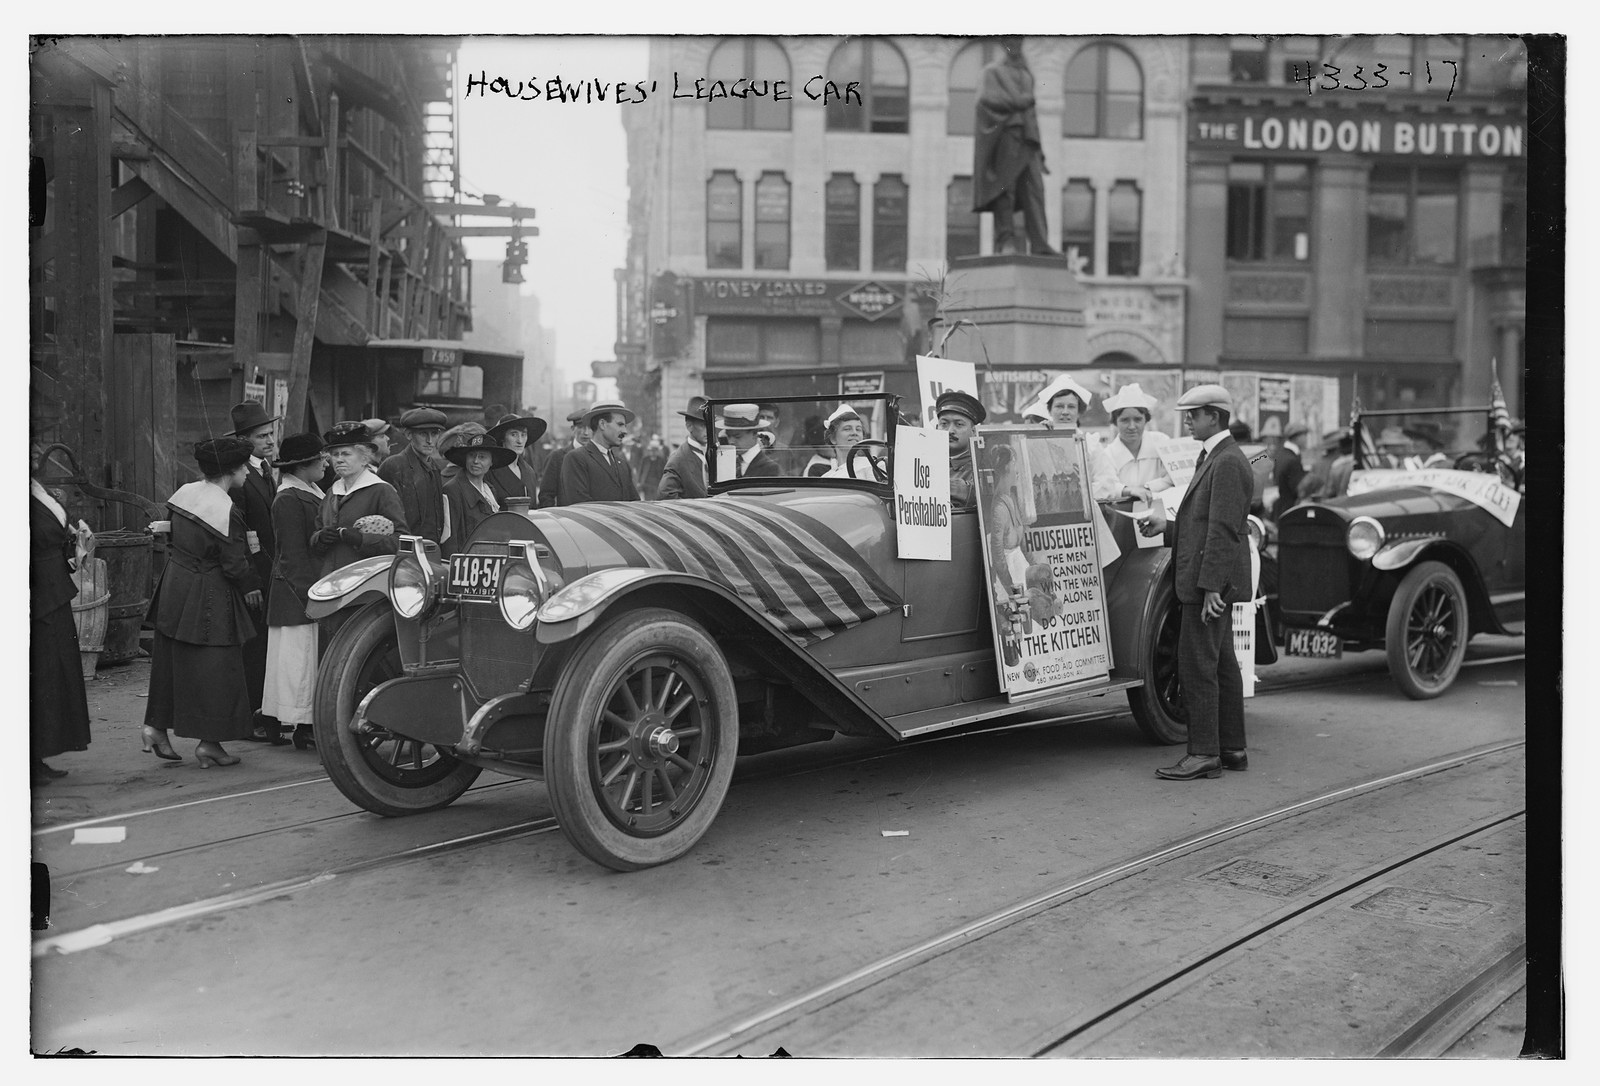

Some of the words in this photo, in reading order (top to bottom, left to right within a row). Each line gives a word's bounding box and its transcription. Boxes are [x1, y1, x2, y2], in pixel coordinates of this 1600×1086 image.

[1198, 122, 1238, 141] THE
[1243, 117, 1382, 152] LONDON
[1394, 122, 1523, 156] BUTTON
[702, 280, 762, 298] MONEY
[913, 457, 931, 489] Use
[897, 494, 949, 528] Perishables
[1024, 526, 1095, 553] HOUSEWIFE!
[1047, 553, 1065, 565] THE
[1066, 550, 1088, 563] MEN
[452, 557, 507, 588] 118-54
[1052, 563, 1094, 578] CANNOT
[1040, 580, 1062, 593] WIN
[1063, 578, 1080, 590] THE
[1081, 575, 1099, 587] WAR
[1063, 590, 1094, 605] ALONE
[1042, 615, 1057, 630] DO
[1059, 611, 1087, 627] YOUR
[1086, 608, 1101, 622] BIT
[1023, 634, 1049, 657] THE
[1050, 624, 1101, 652] KITCHEN
[1006, 672, 1020, 682] NEW
[1022, 667, 1041, 680] YORK
[1042, 663, 1060, 675] FOOD
[1062, 661, 1073, 670] AID
[1074, 653, 1106, 668] COMMITTEE
[1048, 671, 1075, 681] MADISON
